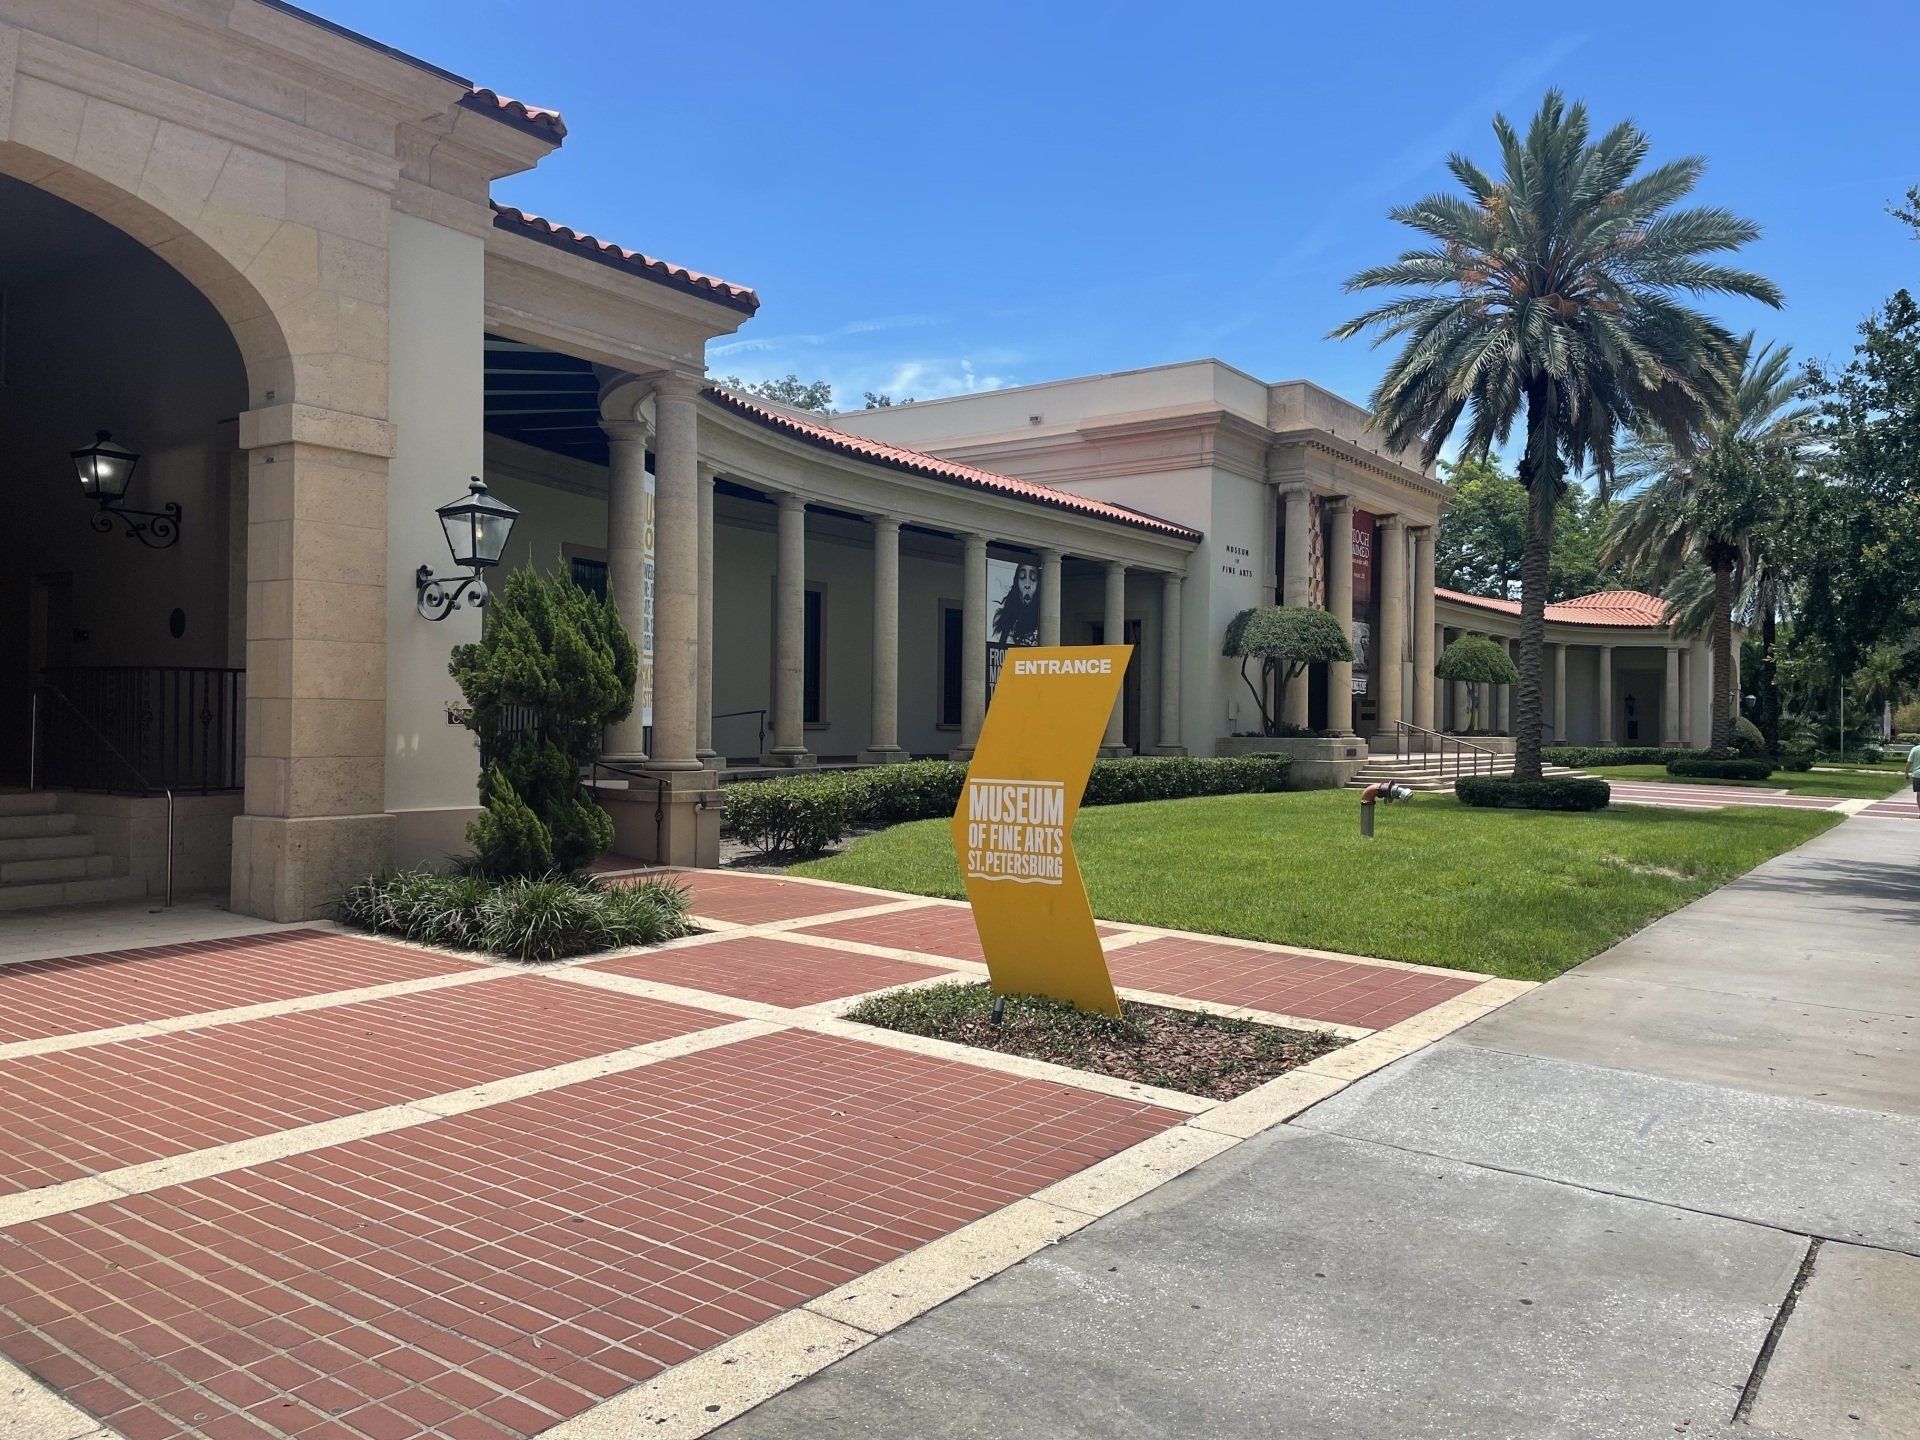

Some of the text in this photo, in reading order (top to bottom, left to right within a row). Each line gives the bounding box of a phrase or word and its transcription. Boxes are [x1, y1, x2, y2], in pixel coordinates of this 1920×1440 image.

[1222, 565, 1252, 578] FINE ARTS
[990, 648, 1005, 666] FRO
[1015, 659, 1112, 675] ENTRANCE
[969, 785, 1064, 826] MUSEUM
[968, 823, 1064, 855] OF FINE ARTS
